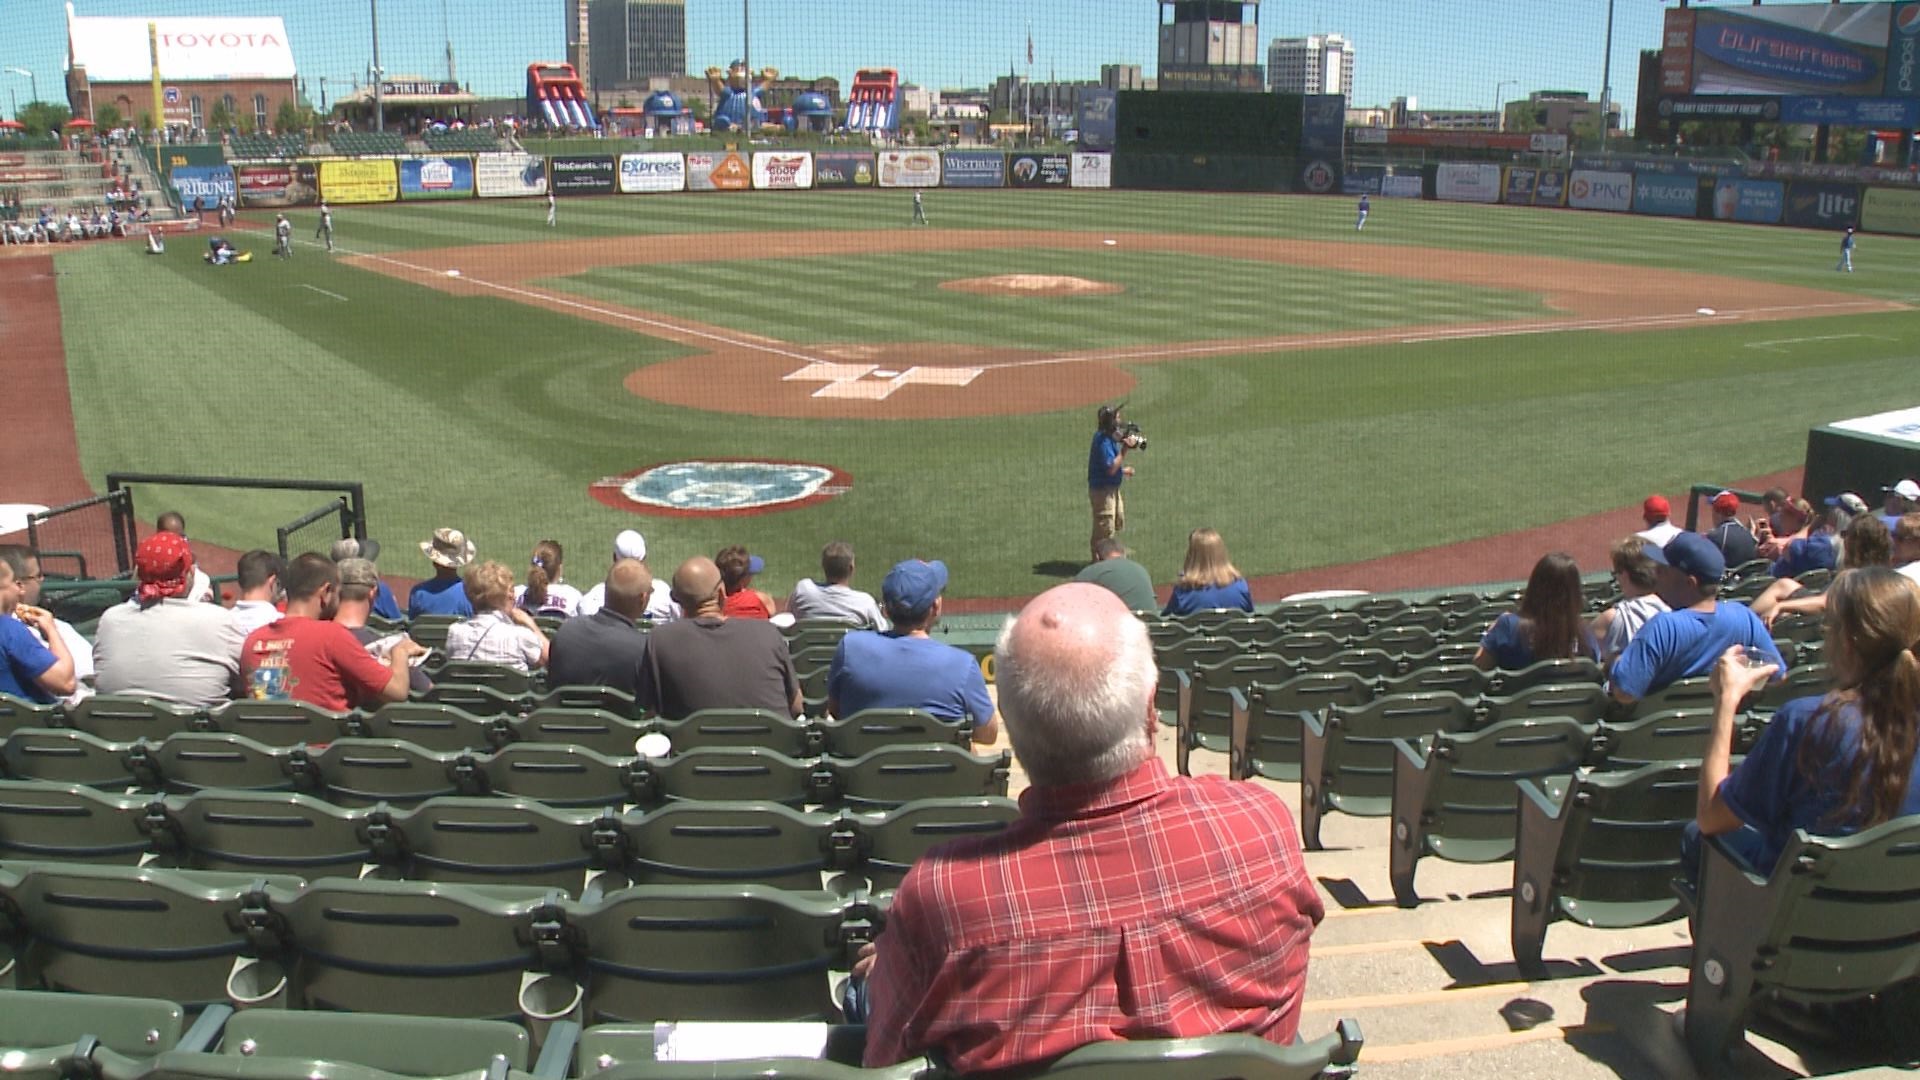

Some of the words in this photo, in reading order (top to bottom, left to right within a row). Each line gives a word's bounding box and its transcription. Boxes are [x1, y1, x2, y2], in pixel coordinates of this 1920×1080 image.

[159, 34, 281, 47] TOYOTA
[1898, 38, 1915, 92] pepsi
[394, 83, 415, 95] TIKI
[418, 83, 441, 95] HUT
[173, 180, 234, 196] TRIBUNE
[1591, 183, 1630, 201] PNC
[1652, 186, 1696, 201] BEACON
[1817, 192, 1855, 218] Lite
